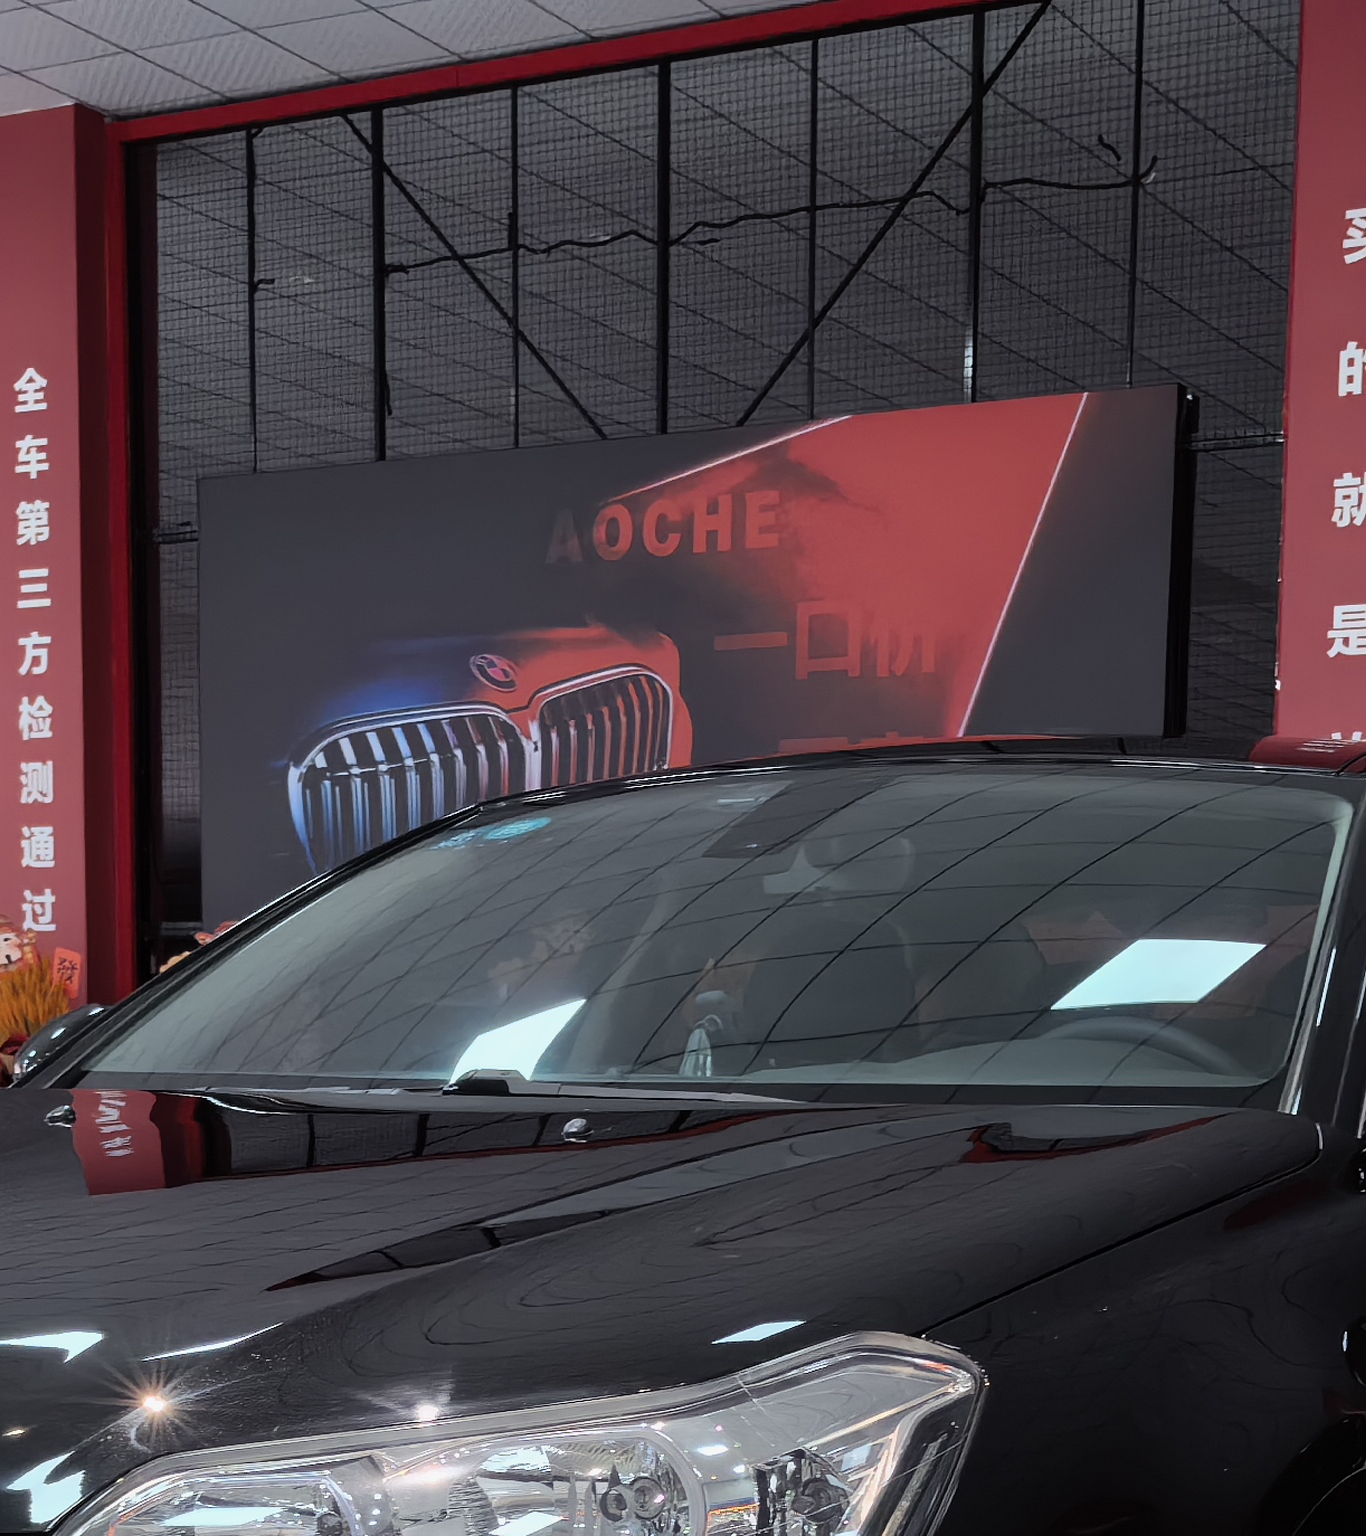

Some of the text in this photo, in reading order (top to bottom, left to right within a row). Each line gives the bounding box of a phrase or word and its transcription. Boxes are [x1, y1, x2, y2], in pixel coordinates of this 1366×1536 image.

[12, 366, 57, 934] 全车第三方检测通过
